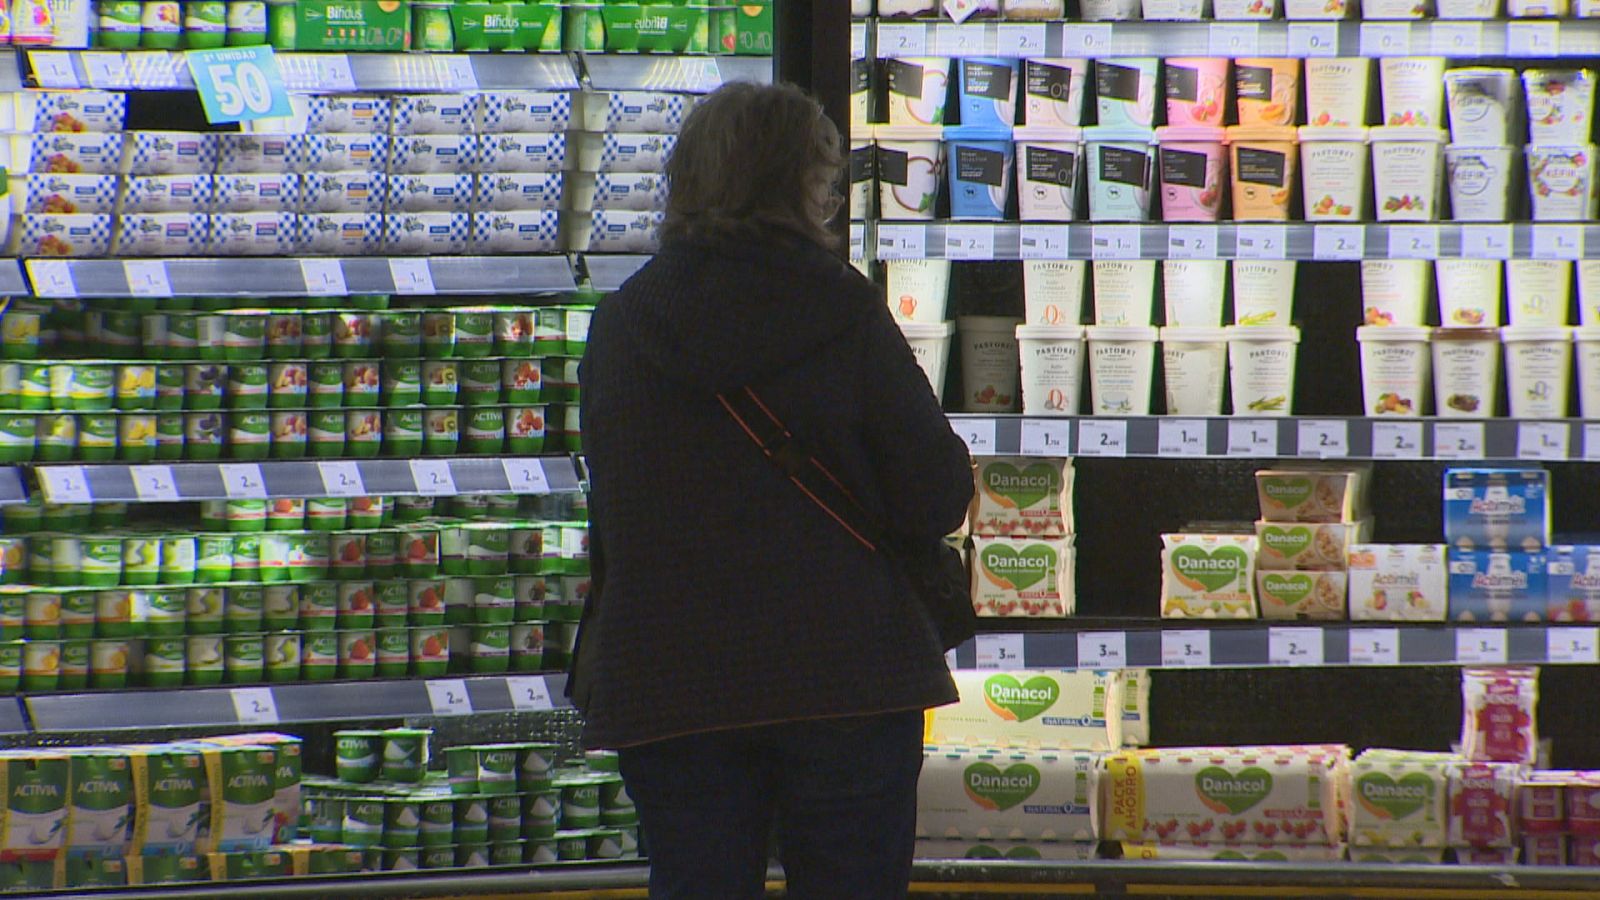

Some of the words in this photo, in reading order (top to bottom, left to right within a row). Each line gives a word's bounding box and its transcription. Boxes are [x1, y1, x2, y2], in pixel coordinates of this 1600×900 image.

[327, 6, 363, 19] Bifidus
[484, 15, 519, 28] Bifidus
[216, 50, 256, 61] UNIDAD
[208, 62, 272, 116] 50
[1033, 262, 1073, 272] PASTORET
[1036, 346, 1076, 356] PASTORET
[1096, 347, 1137, 357] PASTORET
[990, 473, 1050, 487] Danacol
[1266, 485, 1308, 494] Danacol
[1266, 533, 1308, 543] Danacol
[988, 554, 1049, 568] Danacol
[1179, 556, 1240, 569] Danacol
[1266, 581, 1308, 590] Danacol
[1374, 573, 1419, 585] Actimel
[991, 683, 1052, 699] Danacol
[154, 779, 194, 791] ACTIVIA
[228, 775, 268, 788] ACTIVIA
[970, 773, 1032, 787] Danacol
[1202, 778, 1265, 791] Danacol
[14, 784, 58, 796] ACTIVIA
[78, 781, 121, 793] ACTIVIA
[1364, 782, 1424, 797] Danacol
[1114, 779, 1126, 815] PACK
[1126, 766, 1137, 829] AHORRO
